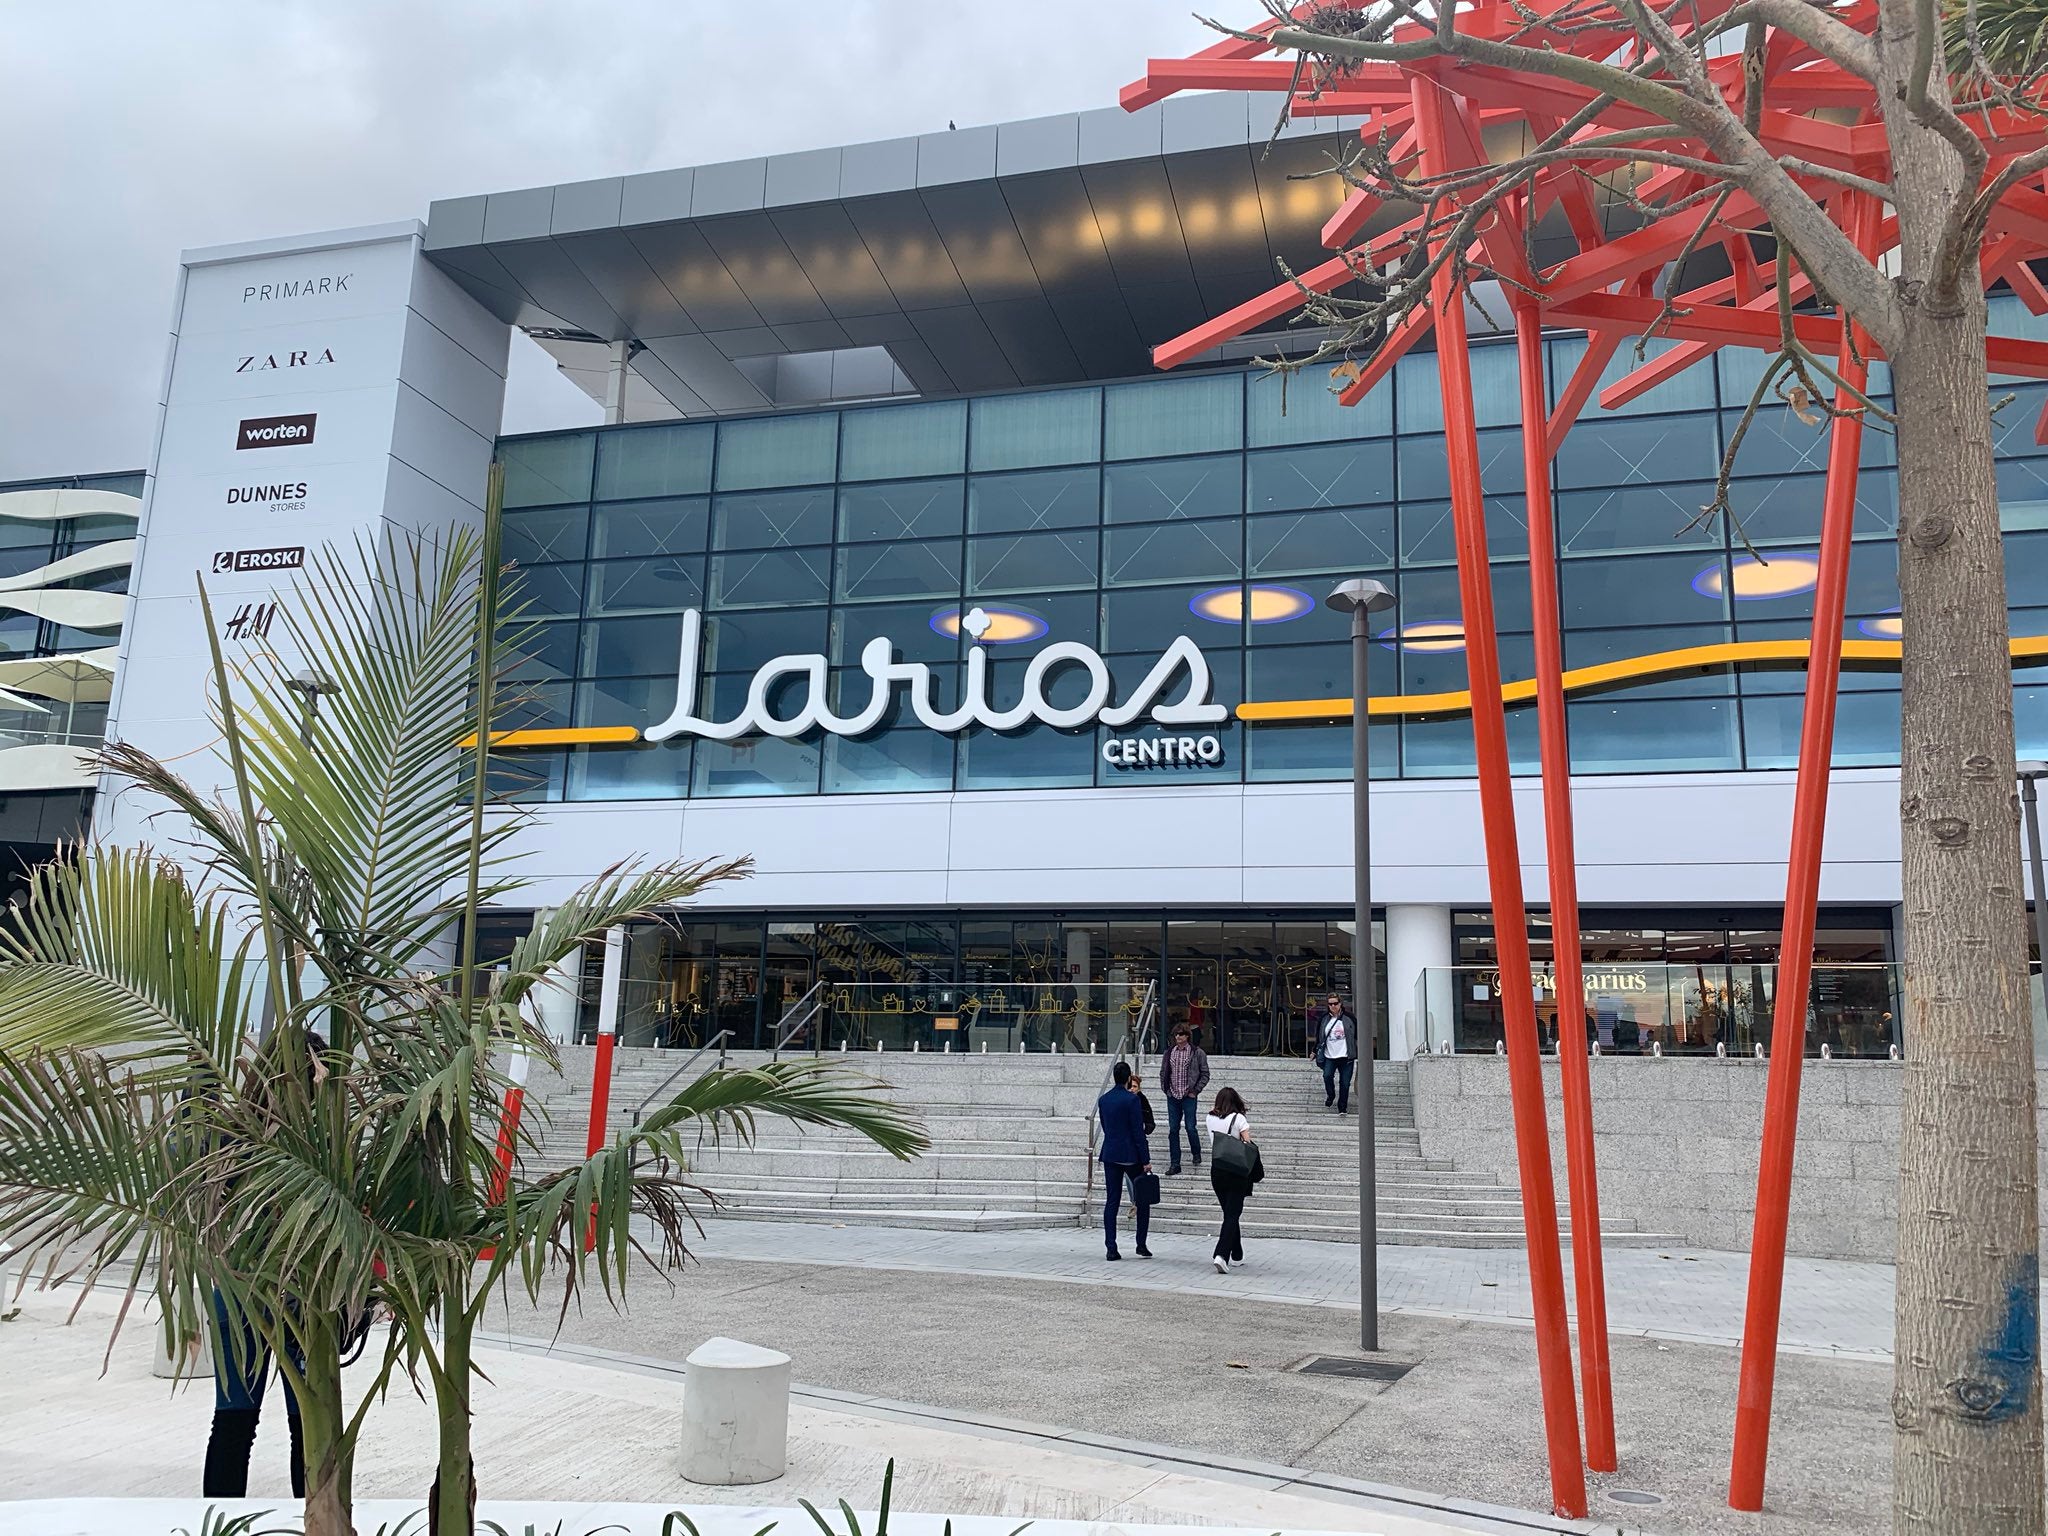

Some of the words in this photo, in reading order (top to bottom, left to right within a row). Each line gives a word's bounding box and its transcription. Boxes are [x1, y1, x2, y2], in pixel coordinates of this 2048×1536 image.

[244, 274, 349, 303] PRIMARK
[236, 348, 336, 373] ZARA
[246, 425, 307, 441] worten
[227, 482, 308, 504] DUNNES
[269, 502, 306, 513] STORES
[239, 551, 300, 569] EROSKI
[224, 602, 277, 641] H&M
[644, 608, 1229, 742] Larios
[1102, 735, 1220, 764] CENTRO
